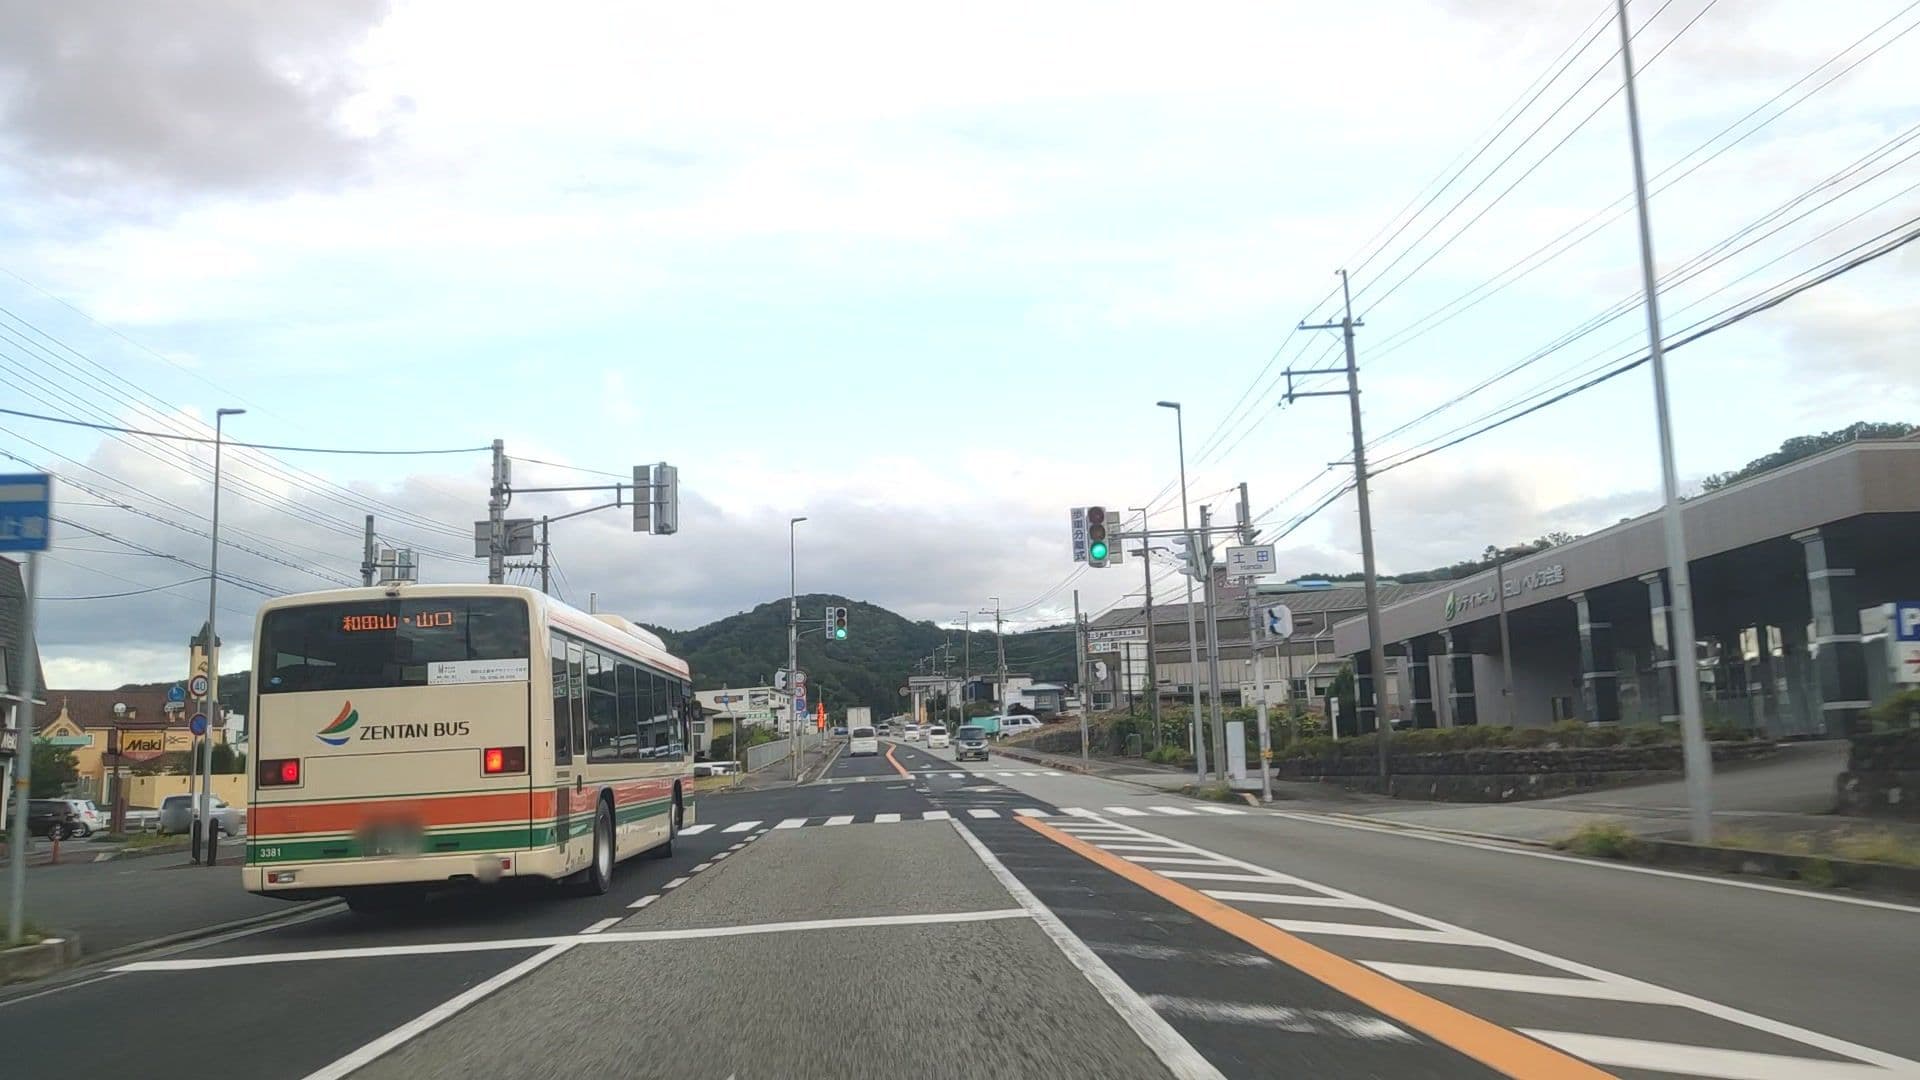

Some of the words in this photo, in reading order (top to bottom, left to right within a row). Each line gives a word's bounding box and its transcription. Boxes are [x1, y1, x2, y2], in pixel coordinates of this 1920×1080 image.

[343, 611, 453, 631] 和田山・山口
[194, 681, 205, 692] 40
[359, 723, 428, 741] ZENTAN
[434, 721, 470, 737] BUS
[124, 738, 161, 751] Maki
[260, 848, 281, 858] 3381
